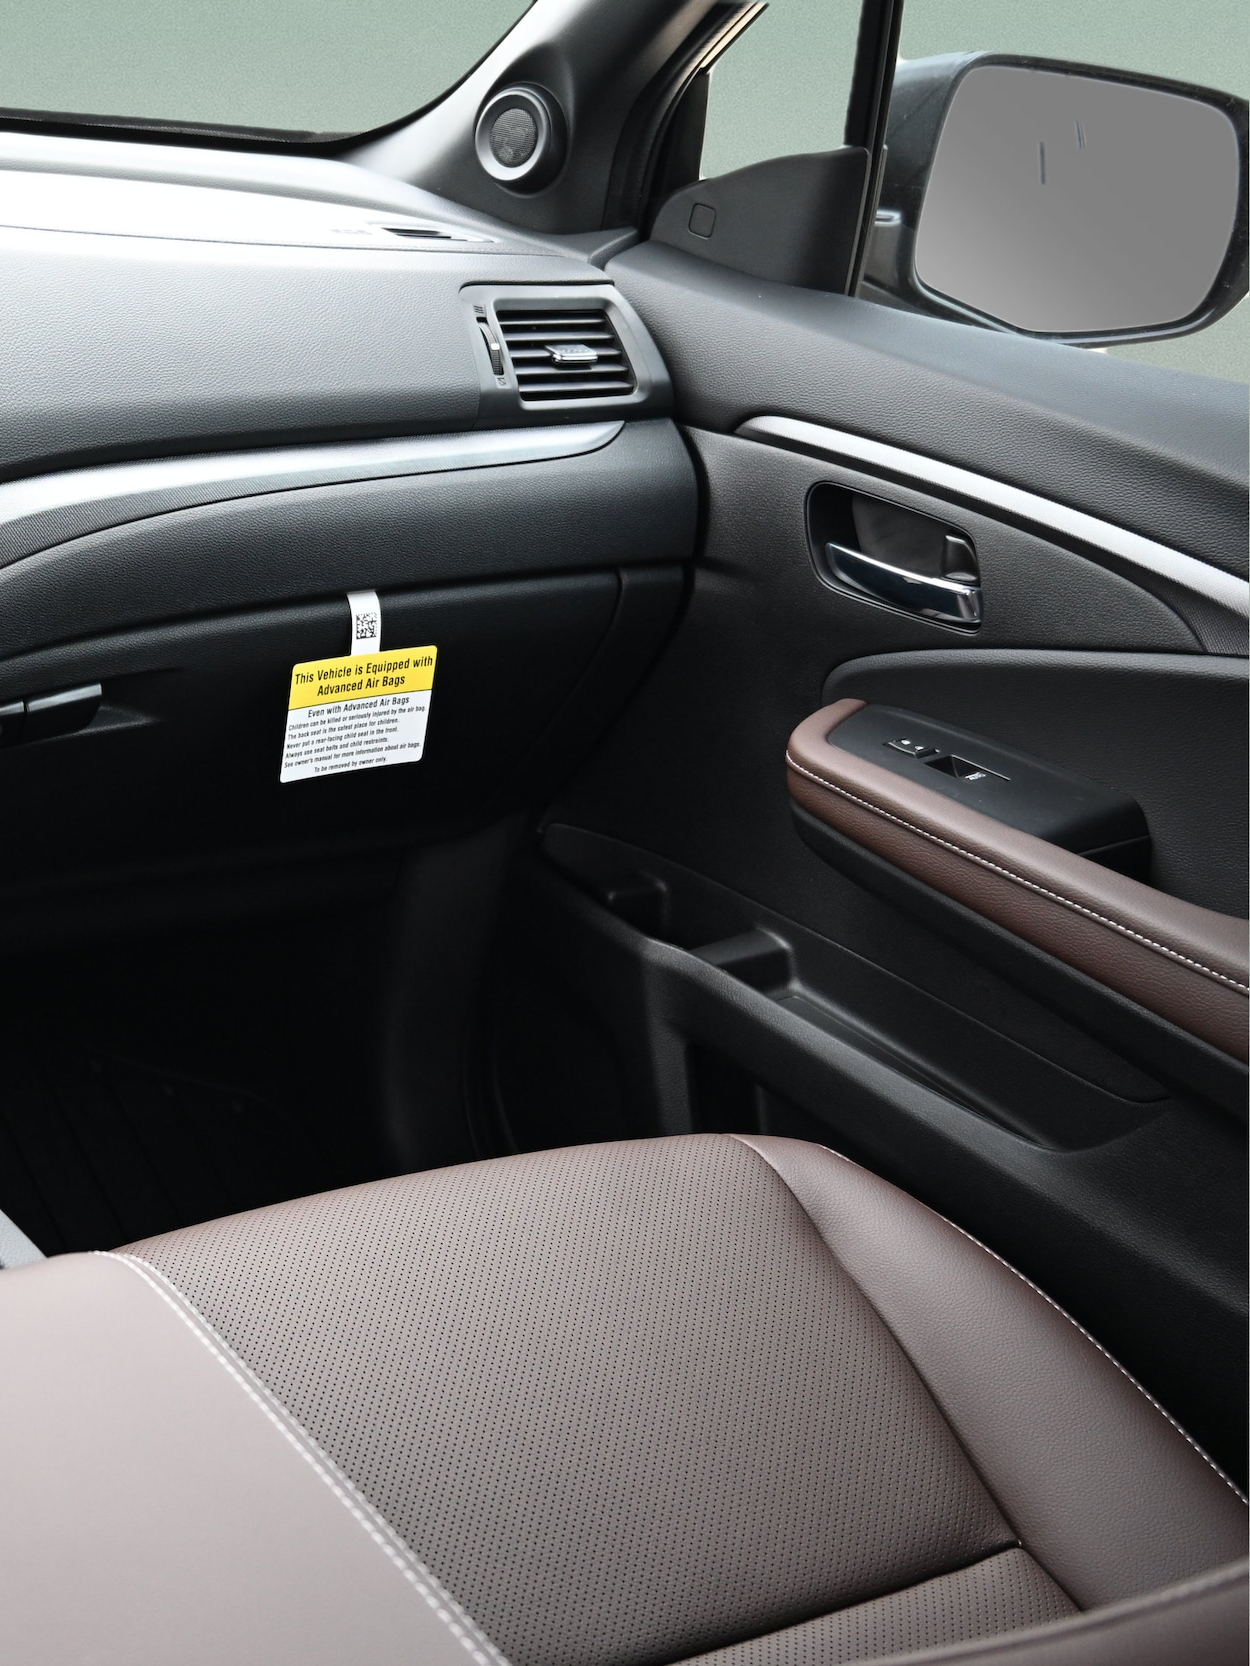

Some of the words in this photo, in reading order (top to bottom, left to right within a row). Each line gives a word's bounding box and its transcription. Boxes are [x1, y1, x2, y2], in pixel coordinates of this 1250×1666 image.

[295, 671, 314, 685] This
[317, 667, 352, 681] Vehicle
[355, 664, 363, 676] is
[366, 657, 411, 675] Equipped
[413, 656, 433, 668] with
[317, 679, 363, 697] Advanced
[365, 677, 380, 689] Air
[382, 675, 406, 688] Bags
[308, 709, 325, 718] Even
[326, 705, 341, 715] with
[343, 700, 378, 712] Advanced
[379, 698, 391, 707] Air
[392, 697, 410, 706] Bags
